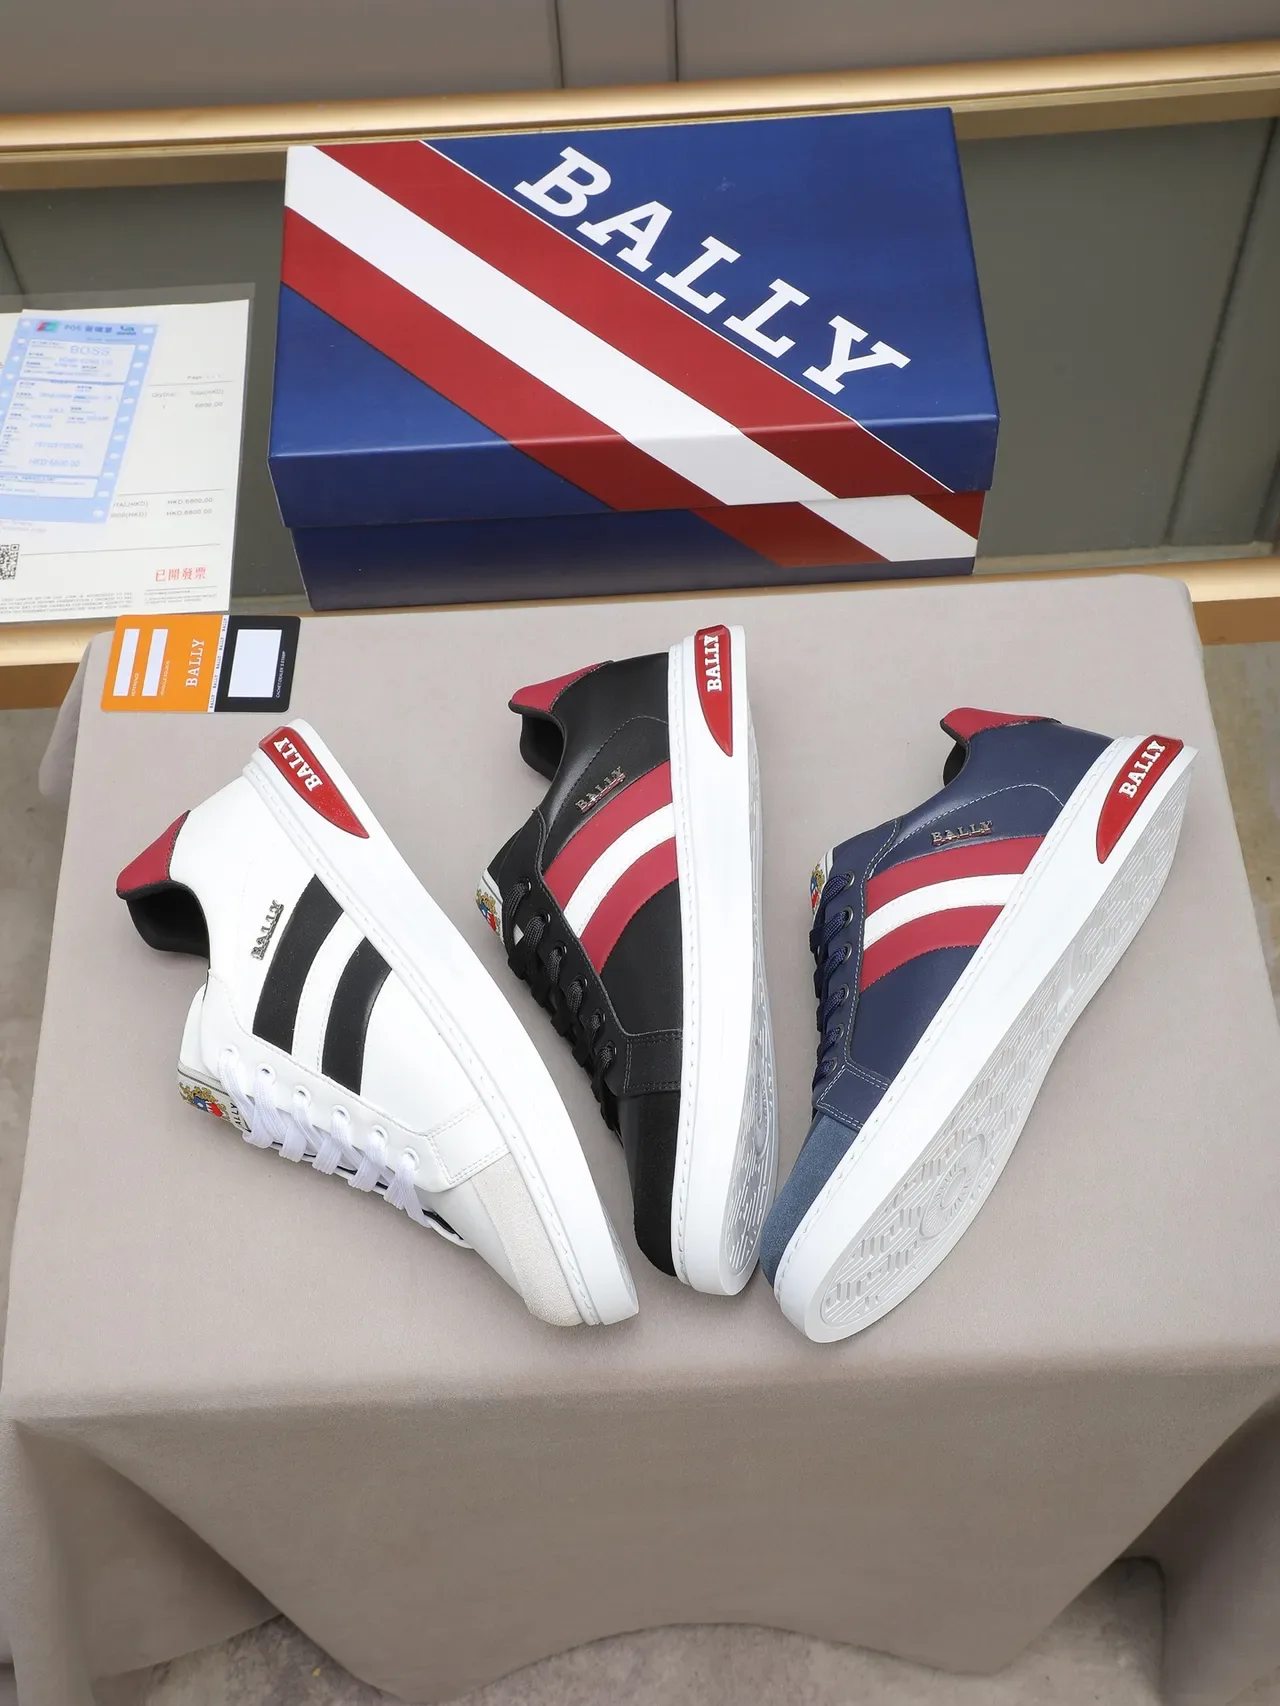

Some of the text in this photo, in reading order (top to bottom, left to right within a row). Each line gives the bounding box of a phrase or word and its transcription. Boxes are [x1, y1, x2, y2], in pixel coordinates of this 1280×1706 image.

[514, 146, 911, 395] BALLY
[70, 346, 110, 356] BOSS
[155, 567, 206, 582] 已開發票
[185, 638, 204, 687] BALLY
[704, 635, 723, 692] BALLY
[273, 737, 323, 791] BALLY
[1118, 740, 1166, 798] BALLY
[575, 766, 626, 814] BALLY
[931, 820, 994, 846] BALLY
[251, 899, 284, 960] BALLY
